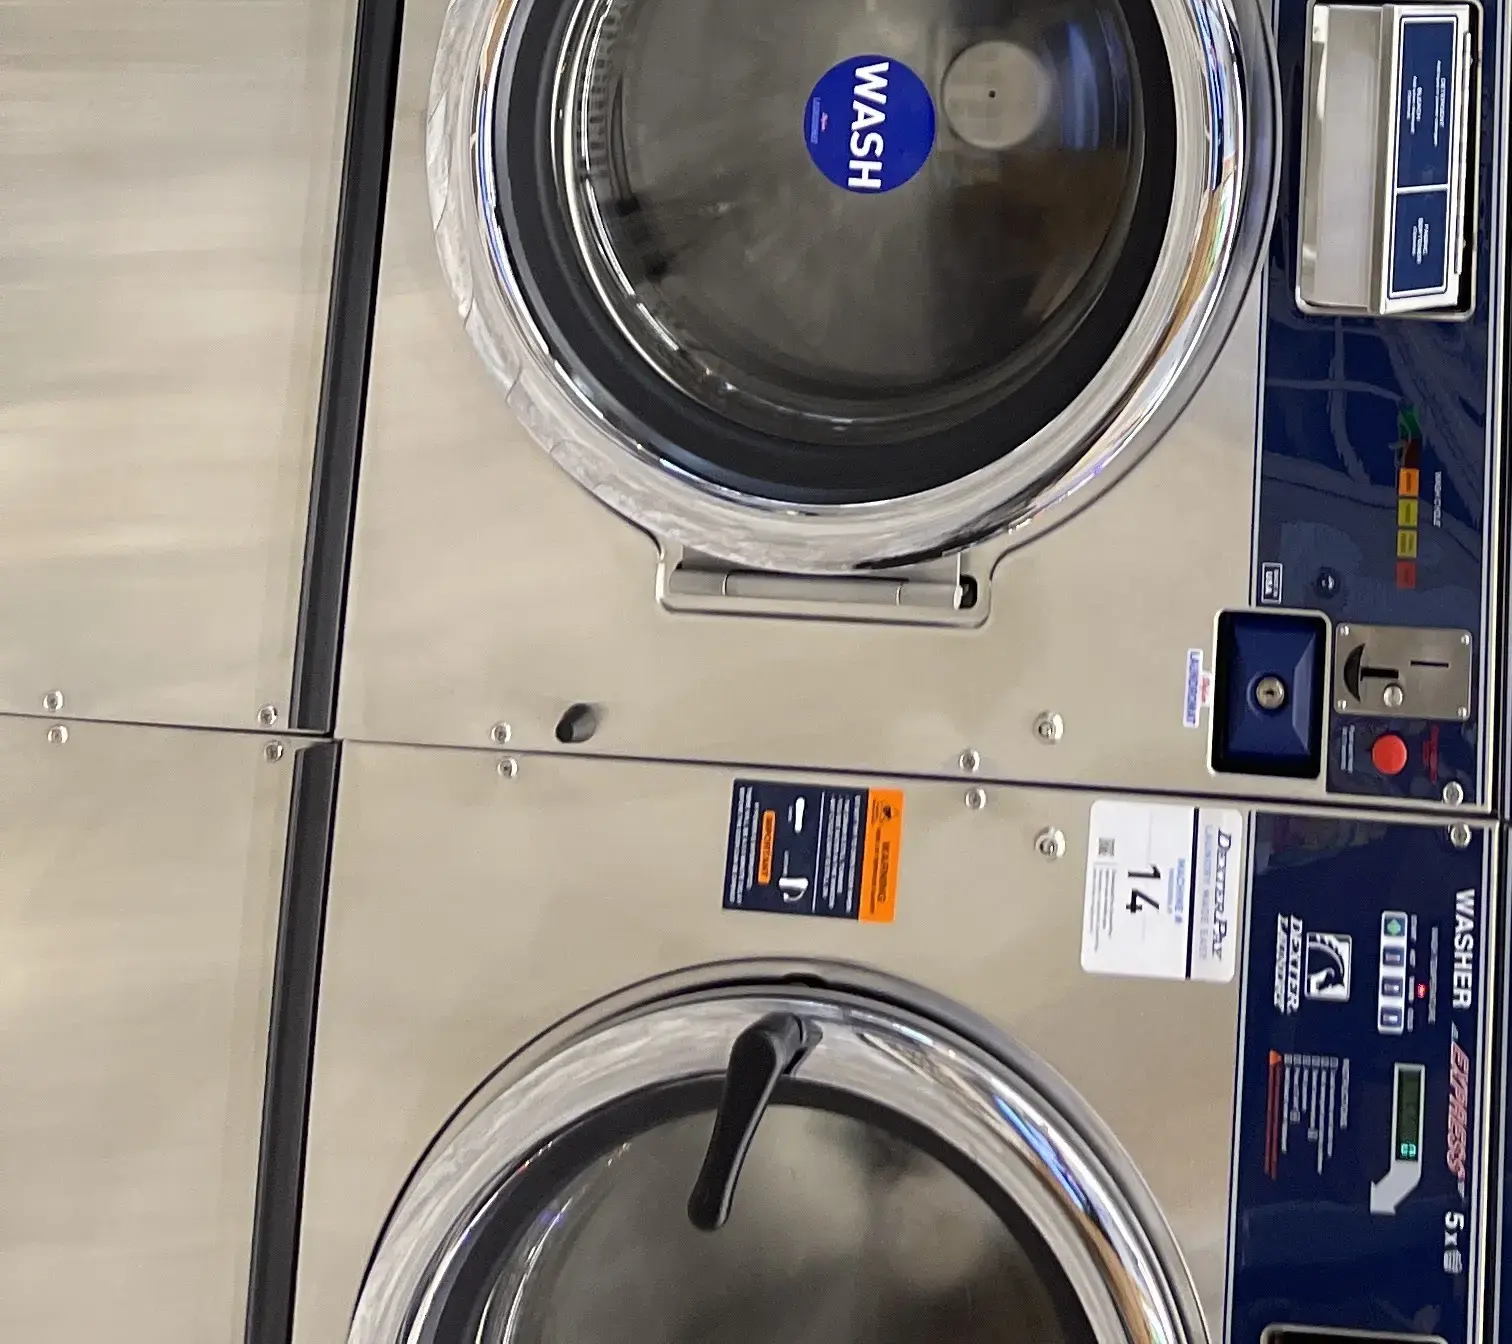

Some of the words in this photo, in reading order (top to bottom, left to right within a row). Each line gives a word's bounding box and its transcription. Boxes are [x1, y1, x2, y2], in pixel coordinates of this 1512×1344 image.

[847, 62, 890, 189] WASH
[1126, 864, 1161, 914] 14
[1287, 915, 1302, 1011] DEXTER
[1453, 889, 1474, 1009] WASHER
[1447, 1042, 1469, 1178] EXPRESS
[1444, 1212, 1463, 1228] 5
[1444, 1231, 1458, 1246] x
